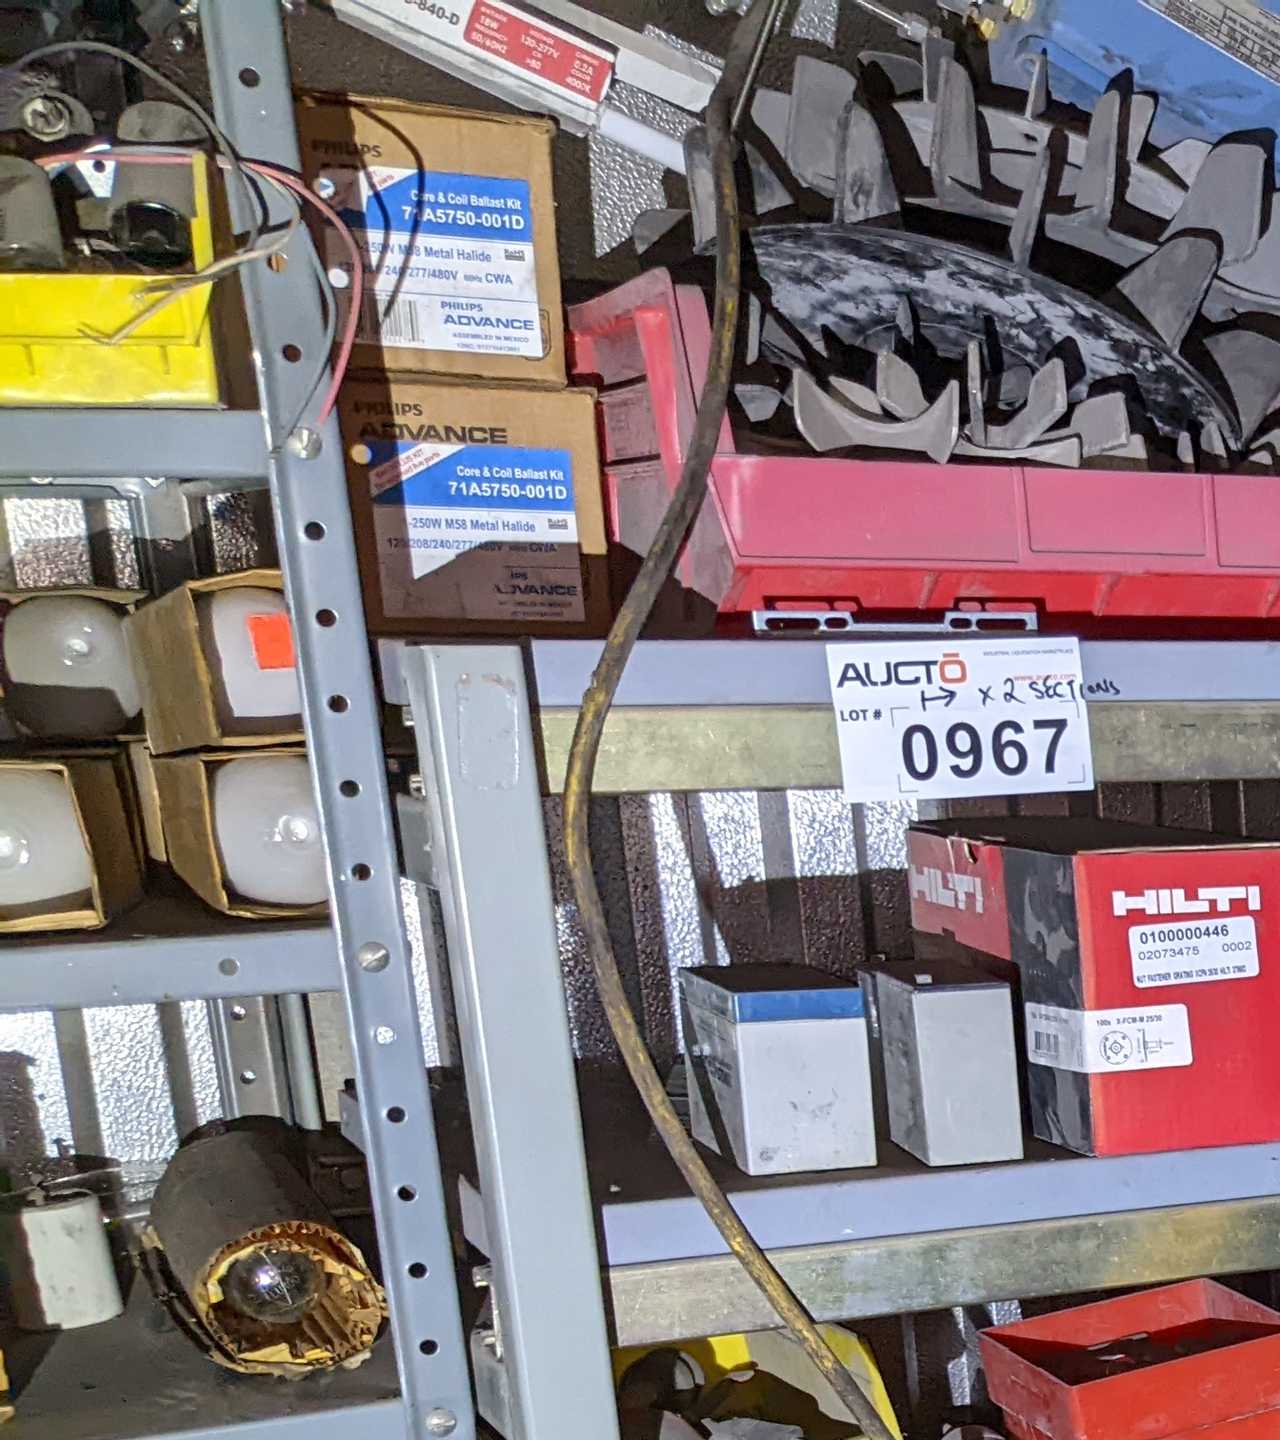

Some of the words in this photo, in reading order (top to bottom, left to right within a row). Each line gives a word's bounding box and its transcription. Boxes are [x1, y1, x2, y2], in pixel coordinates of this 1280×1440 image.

[438, 192, 446, 204] &
[470, 195, 504, 208] Ballast
[506, 199, 522, 211] Kit
[424, 246, 454, 260] Metal
[457, 248, 492, 262] Halide
[485, 273, 513, 285] CWA
[440, 301, 483, 312] PHILIPS
[443, 314, 534, 331] ADVANCE
[360, 423, 507, 444] ADVANCE
[456, 466, 481, 477] Core
[483, 467, 490, 477] &
[492, 467, 512, 478] Coil
[514, 468, 547, 480] Ballast
[549, 470, 564, 481] Kit
[449, 482, 567, 500] 71A5750-001D
[445, 518, 468, 530] M58
[470, 519, 500, 532] Metal
[502, 520, 535, 533] Halide
[1003, 678, 1026, 705] 2
[840, 710, 869, 722] LOT
[873, 709, 882, 720] #
[902, 718, 1068, 781] 0967
[910, 864, 983, 914] HILTI
[1112, 886, 1261, 916] HILTI
[1139, 924, 1229, 945] 0100000446
[1138, 945, 1199, 961] 02073475
[1222, 940, 1253, 953] 0002
